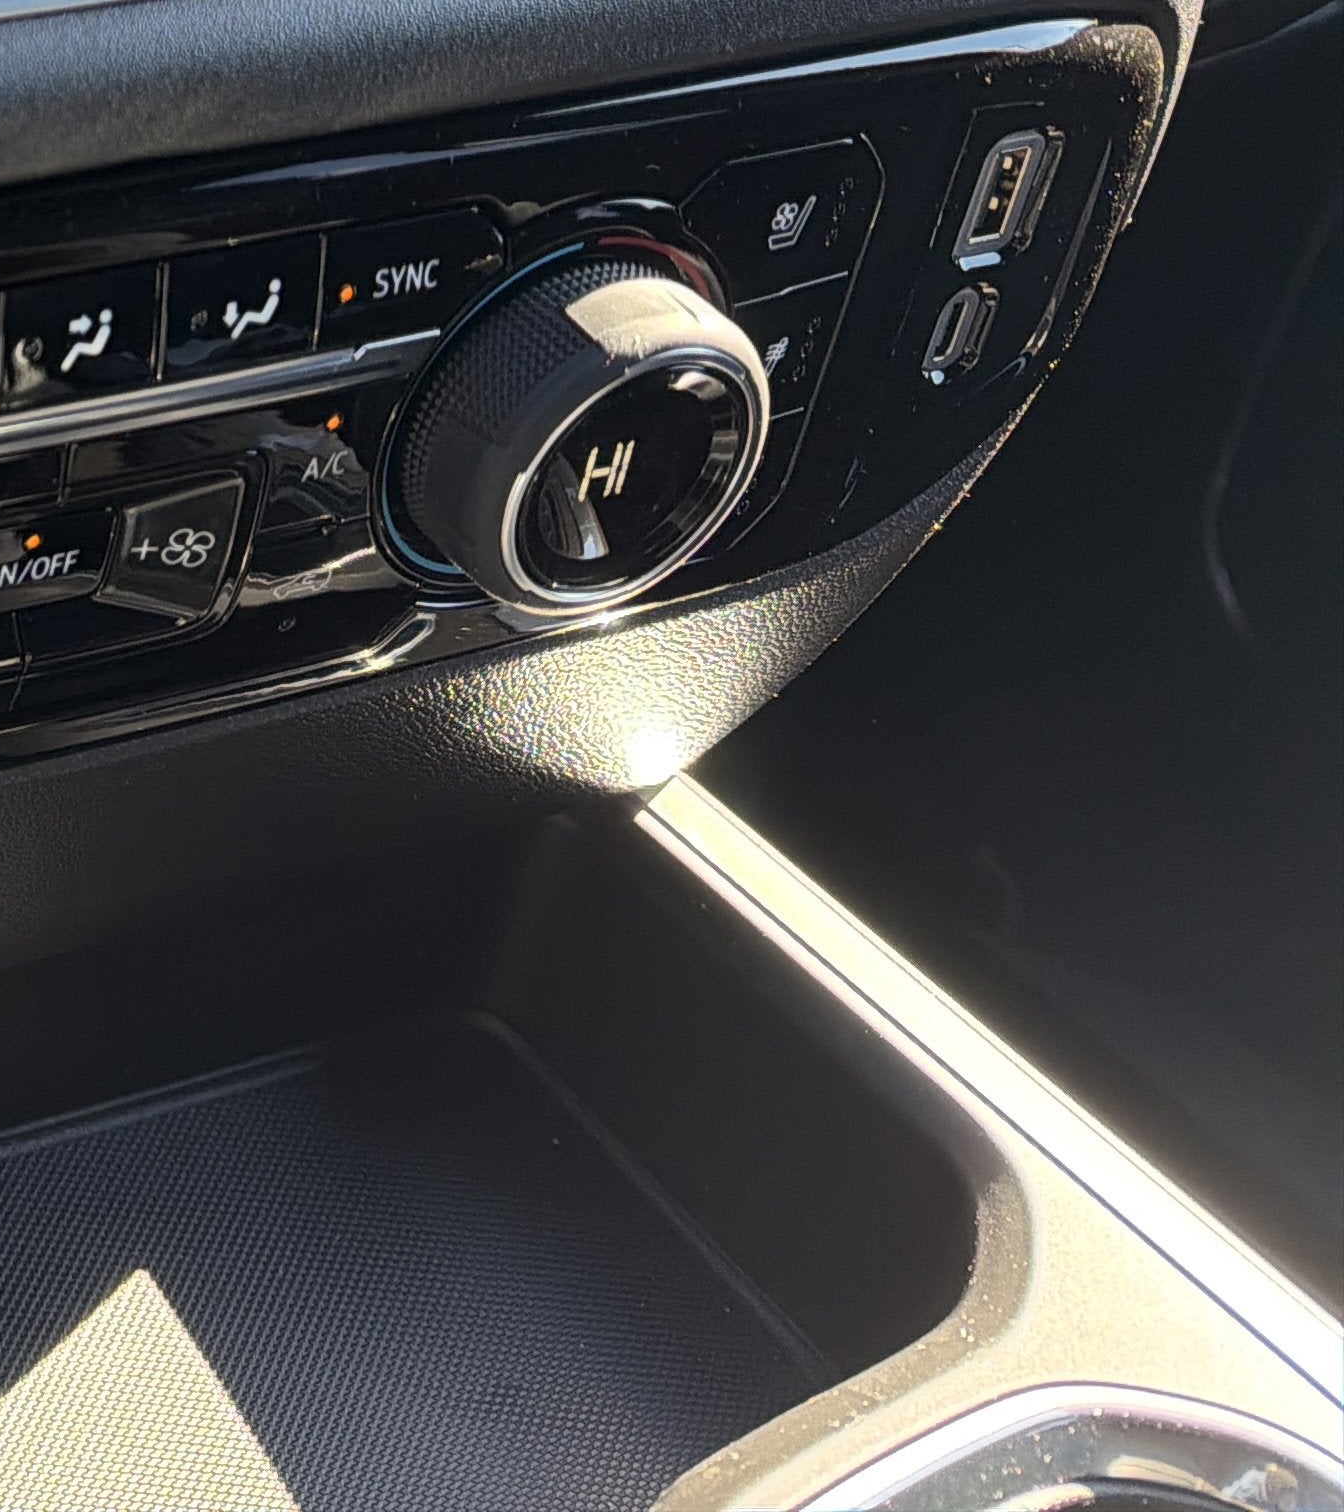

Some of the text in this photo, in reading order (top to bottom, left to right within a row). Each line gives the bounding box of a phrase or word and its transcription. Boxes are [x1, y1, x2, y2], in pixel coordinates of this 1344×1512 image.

[372, 257, 440, 299] SYNC
[301, 449, 349, 483] A/C
[578, 439, 635, 502] HI
